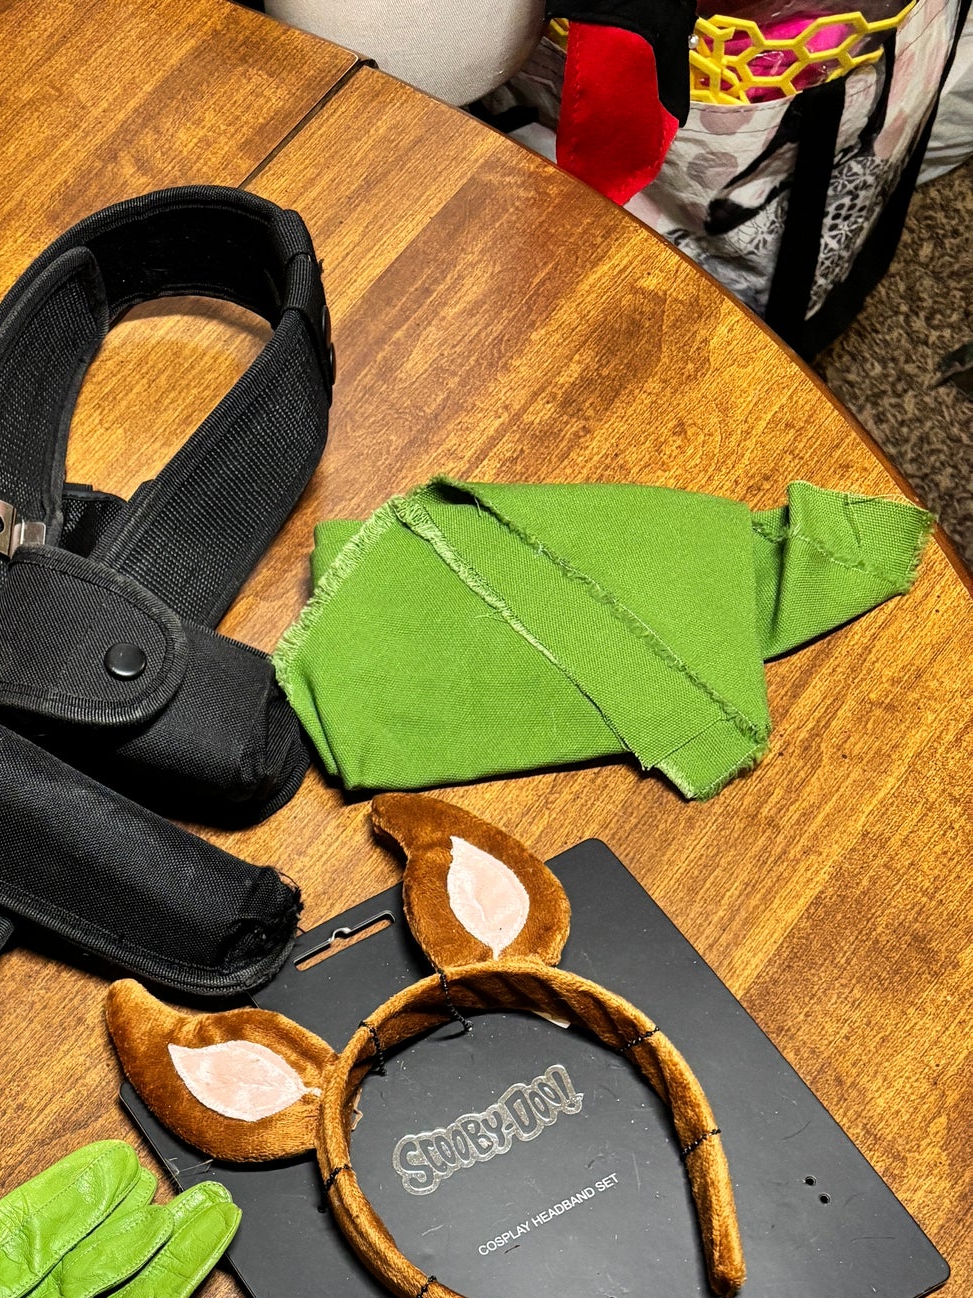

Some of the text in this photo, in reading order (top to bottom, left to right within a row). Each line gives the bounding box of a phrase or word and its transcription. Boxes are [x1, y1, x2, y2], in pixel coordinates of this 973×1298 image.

[478, 1173, 620, 1256] COSPLAY HEADBAND SET
